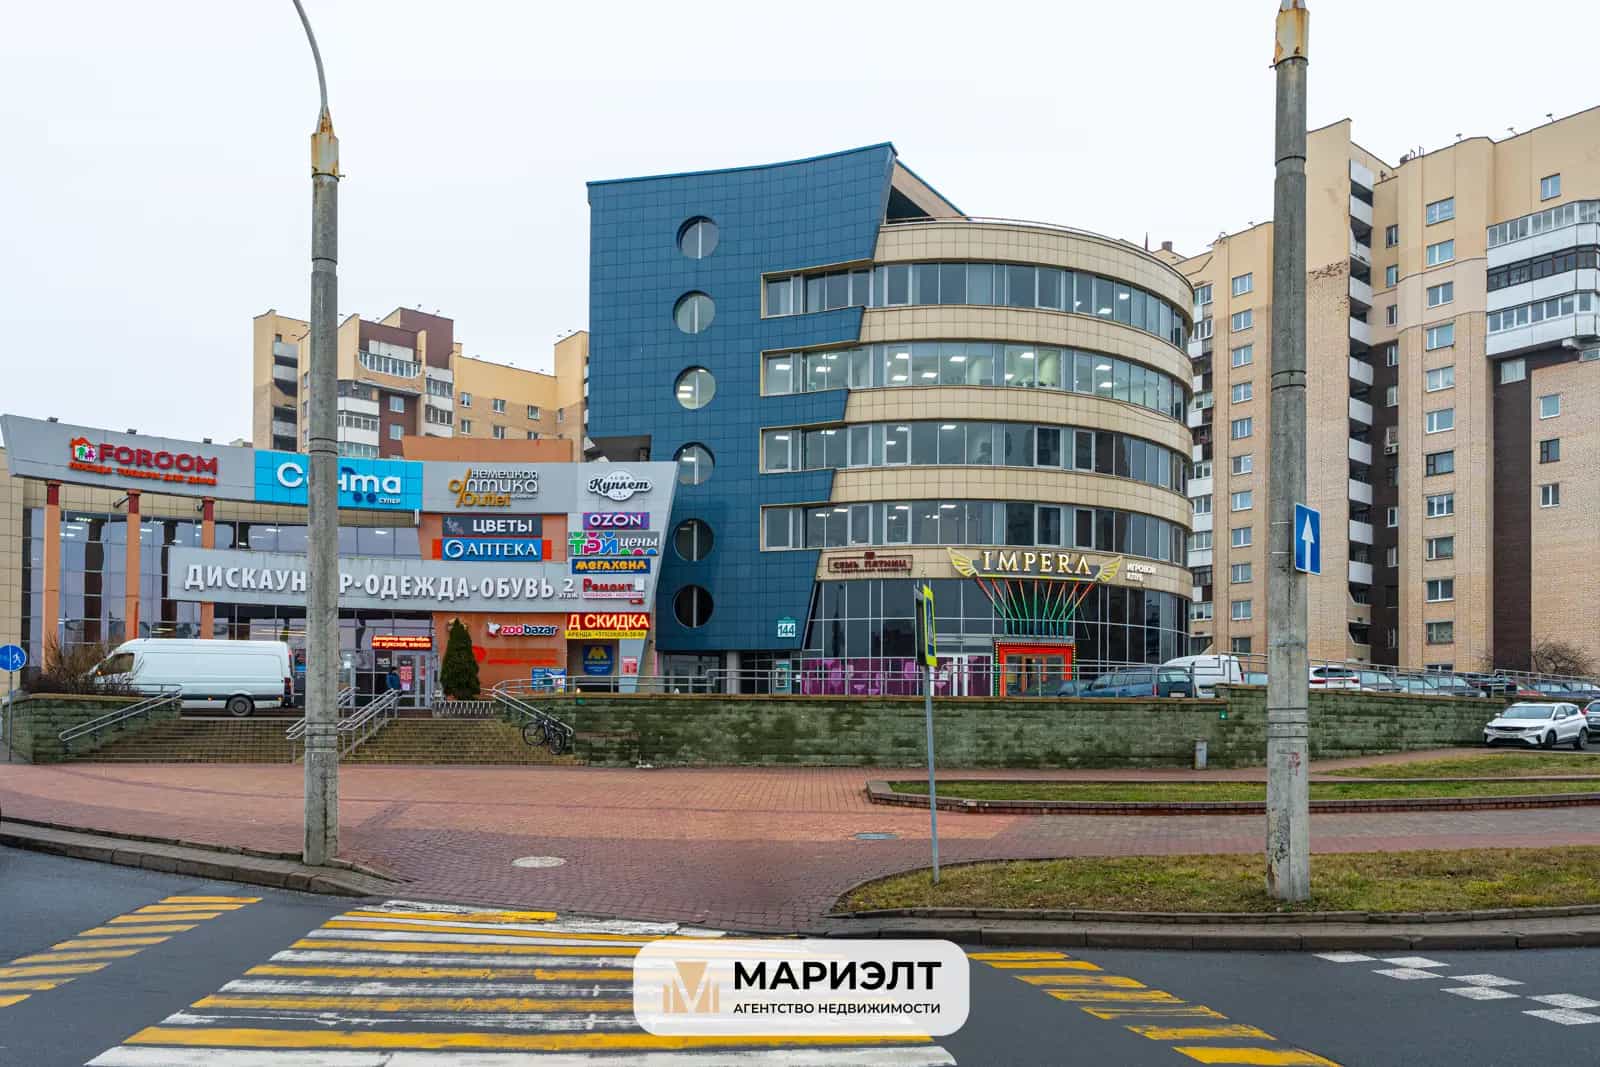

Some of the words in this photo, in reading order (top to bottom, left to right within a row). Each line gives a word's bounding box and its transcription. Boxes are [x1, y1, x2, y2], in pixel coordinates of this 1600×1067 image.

[99, 443, 218, 475] FOROOM
[589, 478, 649, 494] Куплет
[472, 519, 533, 533] ЦВЕТЫ
[590, 514, 641, 526] OZON
[466, 543, 537, 556] АПТЕКА
[620, 537, 658, 549] цены
[983, 551, 1092, 575] IMPERA
[563, 578, 574, 592] 2
[583, 577, 633, 592] Ремонт
[569, 614, 580, 630] Д
[584, 614, 649, 630] СКИДКА
[502, 624, 558, 635] zoobazar
[780, 624, 795, 635] 144
